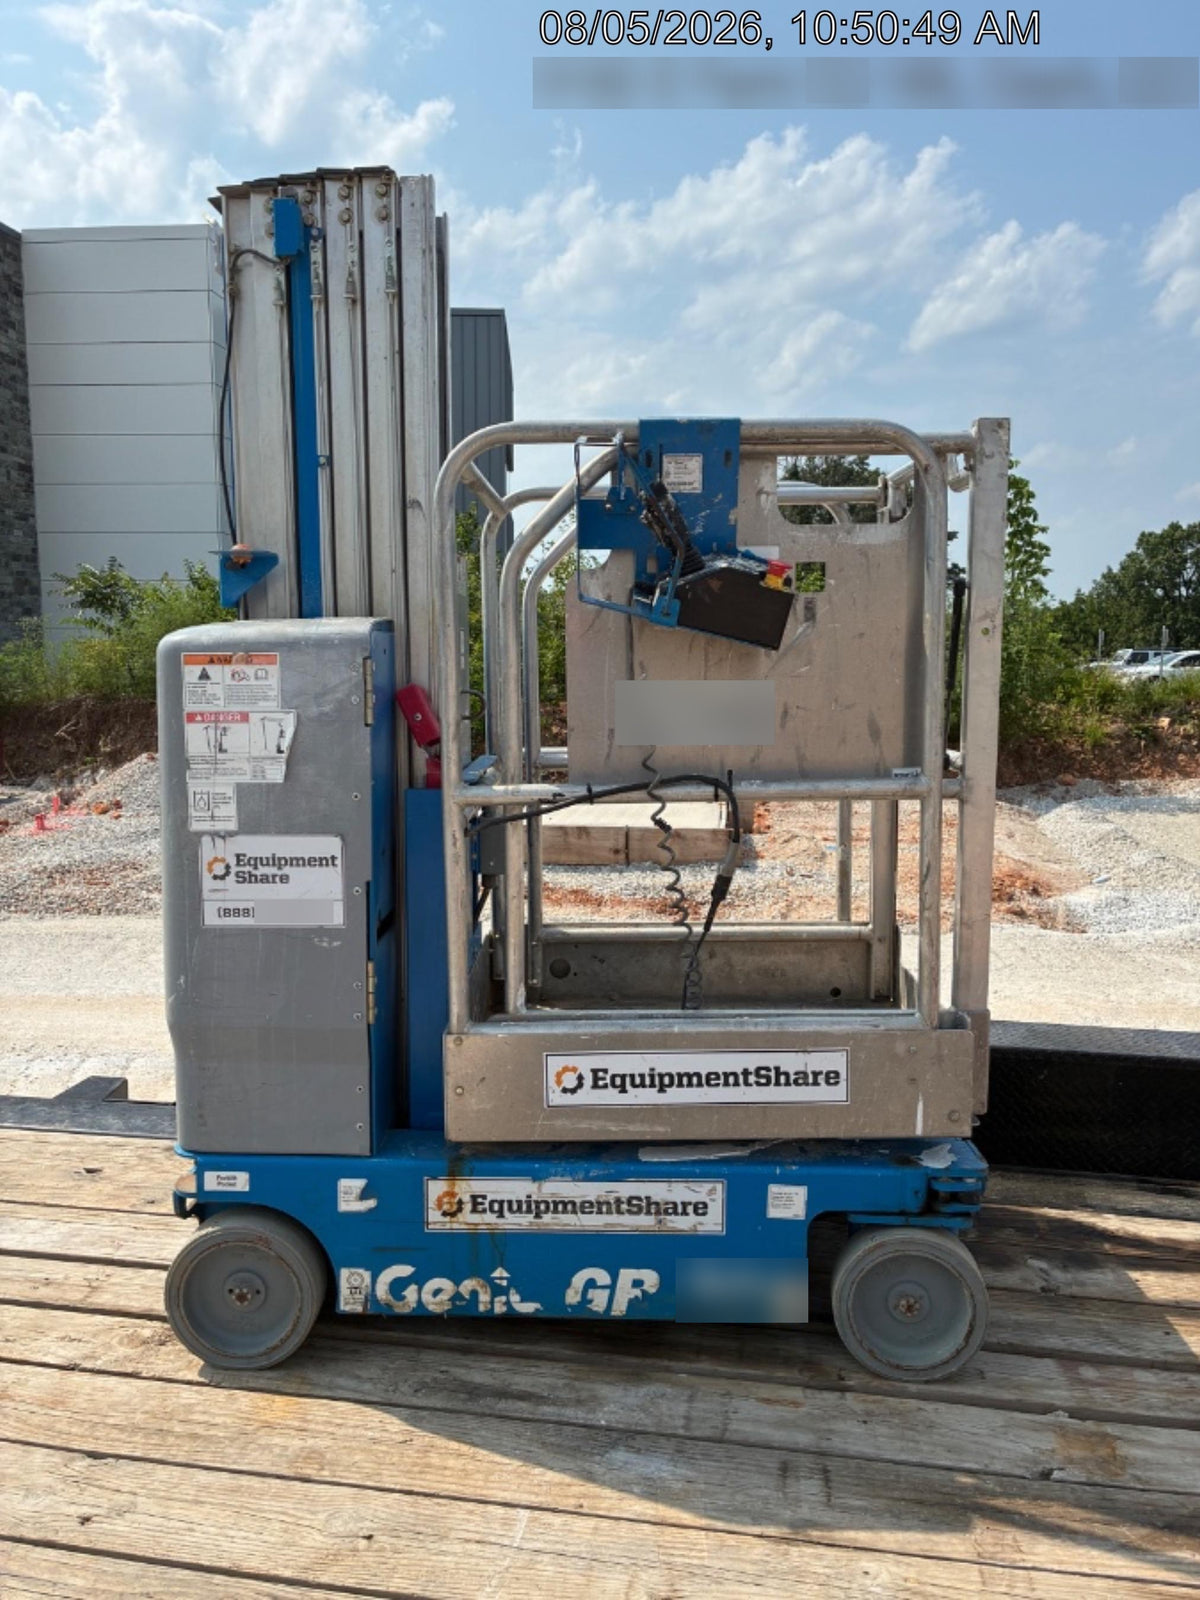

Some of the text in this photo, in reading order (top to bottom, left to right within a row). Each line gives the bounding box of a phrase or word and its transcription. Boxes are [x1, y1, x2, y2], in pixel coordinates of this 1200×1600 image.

[234, 853, 338, 871] Equipment
[234, 871, 290, 884] Share
[590, 1065, 841, 1094] EquipmentShare
[469, 1194, 708, 1219] EquipmentShare
